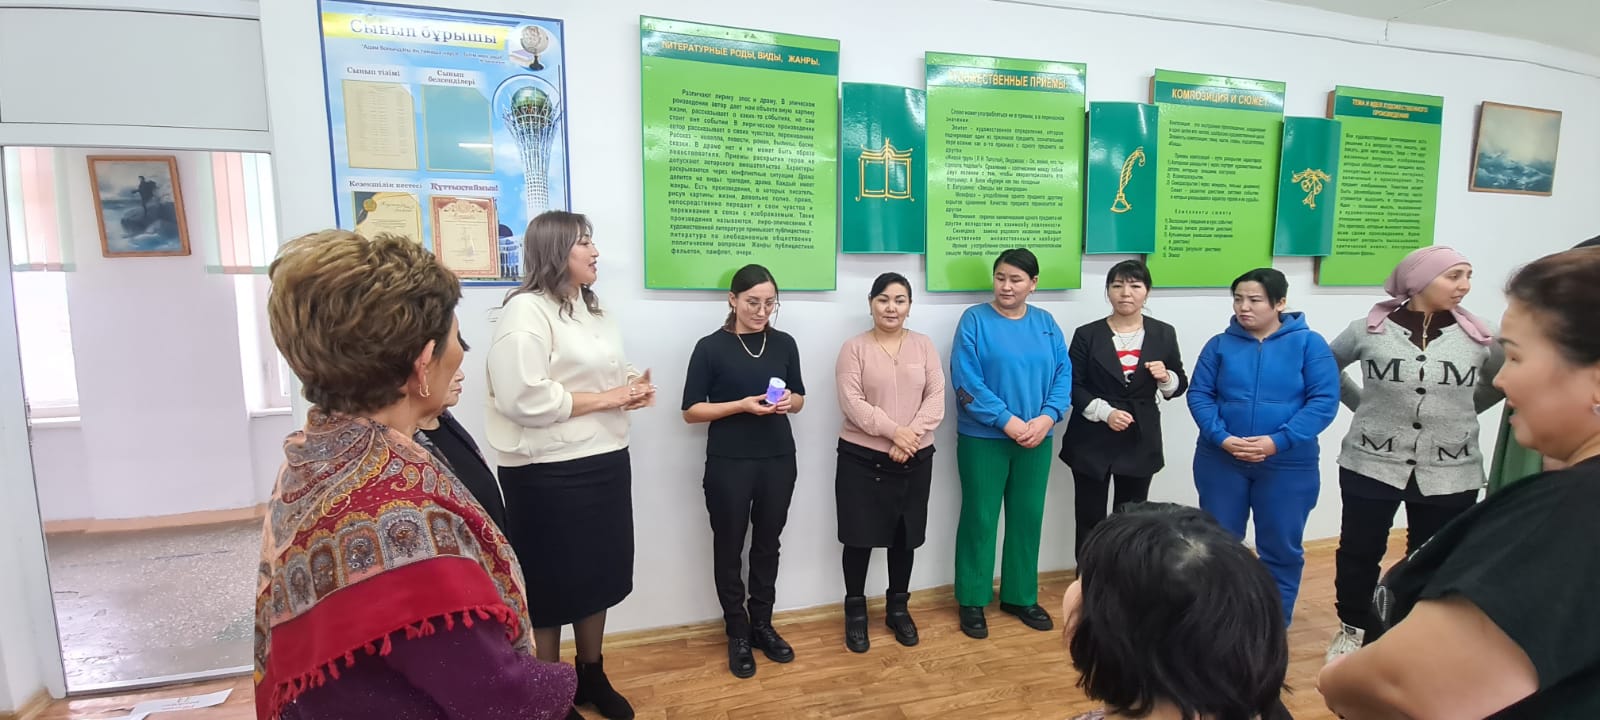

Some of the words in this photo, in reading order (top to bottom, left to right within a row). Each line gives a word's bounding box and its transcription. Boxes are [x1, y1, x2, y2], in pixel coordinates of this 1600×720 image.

[730, 49, 755, 60] РОДЫ,
[758, 52, 783, 62] ВИДЫ,
[347, 67, 375, 76] Сынып
[437, 70, 464, 78] Сынып
[1172, 88, 1228, 104] КОМПОЗИЦИЯ
[1231, 95, 1236, 103] И
[1366, 358, 1406, 382] M
[1438, 360, 1477, 387] M
